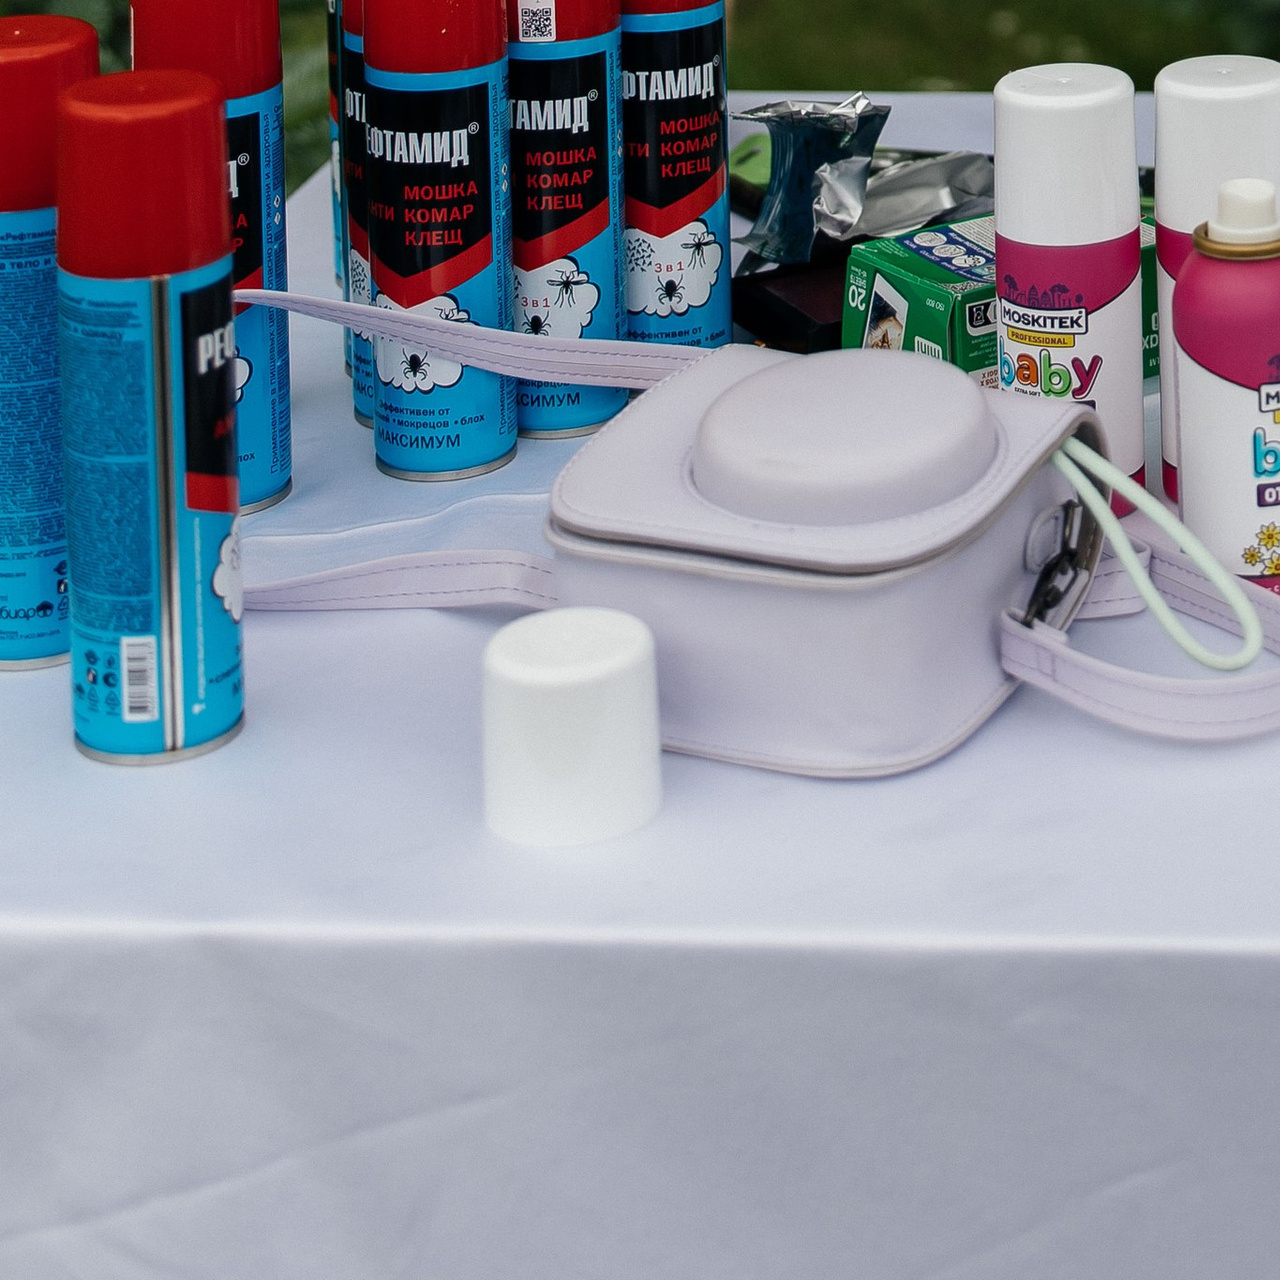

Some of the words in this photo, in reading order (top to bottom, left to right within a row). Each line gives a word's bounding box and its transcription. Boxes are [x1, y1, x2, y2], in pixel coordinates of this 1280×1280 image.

[622, 61, 715, 101] ФТАМИД
[491, 83, 500, 138] здоровья
[509, 96, 590, 134] ТАМИД
[262, 112, 271, 150] здоровья
[660, 110, 720, 135] МОШКА
[366, 123, 470, 168] ЕФТАМИД
[661, 131, 718, 157] КОМАР
[526, 146, 597, 167] МОШКА
[661, 156, 711, 178] КЛЕЩ
[492, 151, 501, 188] жизни
[527, 169, 594, 189] КОМАР
[264, 183, 272, 220] жизни
[404, 181, 478, 201] МОШКА
[493, 190, 501, 212] для
[527, 193, 583, 211] КЛЕЩ
[369, 202, 395, 222] НТИ
[404, 204, 474, 224] КОМАР
[265, 223, 273, 245] для
[405, 231, 463, 246] КЛЕЩ
[494, 214, 502, 256] опасно
[265, 248, 274, 291] опасно
[654, 262, 663, 273] 3
[676, 261, 685, 272] 1
[521, 296, 529, 307] 3
[542, 297, 551, 308] 1
[848, 284, 866, 311] 20
[1002, 306, 1084, 329] MOSKITEK
[1011, 330, 1068, 345] PROFESSIONAL
[268, 330, 276, 385] пищевых
[999, 335, 1104, 400] baby
[518, 392, 580, 408] СИМУМ
[396, 419, 449, 430] мокрецов
[460, 414, 485, 426] блох
[438, 408, 450, 416] от
[270, 399, 280, 475] Применение
[238, 452, 255, 464] лох
